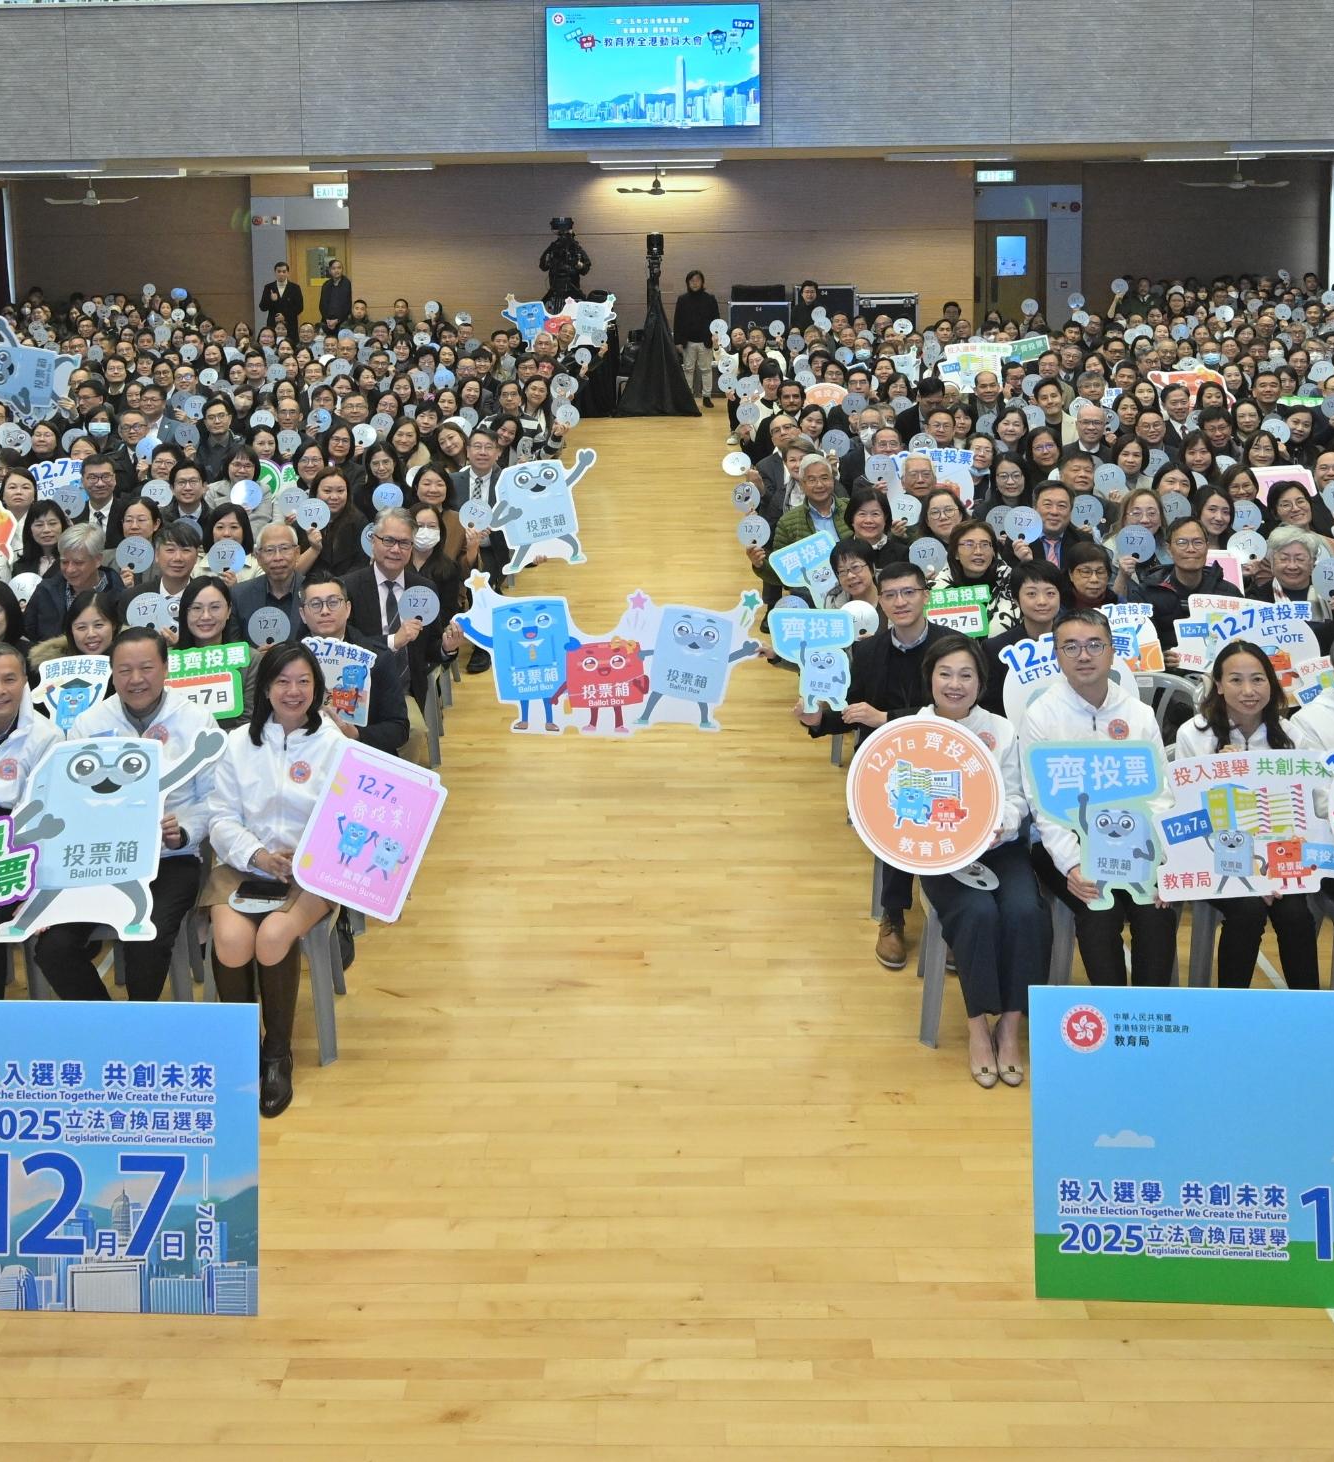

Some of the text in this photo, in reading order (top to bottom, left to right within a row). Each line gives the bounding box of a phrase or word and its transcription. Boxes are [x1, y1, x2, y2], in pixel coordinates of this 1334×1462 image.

[603, 36, 702, 47] 教育界全港動員大會
[525, 514, 565, 532] 投票箱
[779, 536, 834, 572] 齊投票
[1192, 597, 1240, 612] 投入選舉
[781, 617, 847, 642] 齊投票
[1213, 604, 1310, 640] 12.7 齊投票
[1261, 625, 1288, 637] LET'S
[1276, 633, 1304, 644] VOTE
[45, 657, 109, 678] 踴躍投票
[511, 667, 559, 686] 投票箱
[666, 668, 707, 689] 投票箱
[581, 681, 630, 699] 投票箱
[866, 731, 986, 778] 12月7日 齊投票
[1046, 755, 1149, 796] 齊投票
[1173, 757, 1334, 786] 投入選舉 共創未來
[1166, 816, 1208, 838] 12月7日
[63, 841, 139, 868] 投票箱
[897, 837, 956, 857] 教育局
[69, 866, 127, 880] Ballot Box
[1163, 871, 1212, 889] 教育局
[1113, 1013, 1172, 1022] 中華人民共和國
[1113, 1023, 1190, 1033] 香港特別行政區政府
[1114, 1035, 1150, 1047] 教育局
[105, 1064, 213, 1088] 共創未來
[17, 1091, 57, 1100] Election
[60, 1092, 106, 1103] Together
[108, 1092, 124, 1100] We
[125, 1092, 159, 1101] Create
[161, 1092, 178, 1101] the
[181, 1093, 214, 1103] Future
[66, 1110, 213, 1131] 立法會換屆選舉
[66, 1134, 213, 1144] Legislative Council General Election
[1060, 1180, 1285, 1207] 投入選舉 共創未來
[1060, 1206, 1080, 1215] Join
[1100, 1207, 1138, 1215] Election
[1141, 1208, 1184, 1218] Together
[1186, 1209, 1200, 1217] We
[1203, 1209, 1234, 1218] Create
[1255, 1211, 1287, 1220] Future
[198, 1221, 213, 1257] DEC
[1061, 1223, 1286, 1252] 2025 立法會換屆選舉
[1148, 1247, 1287, 1258] Legislative Council General Election
